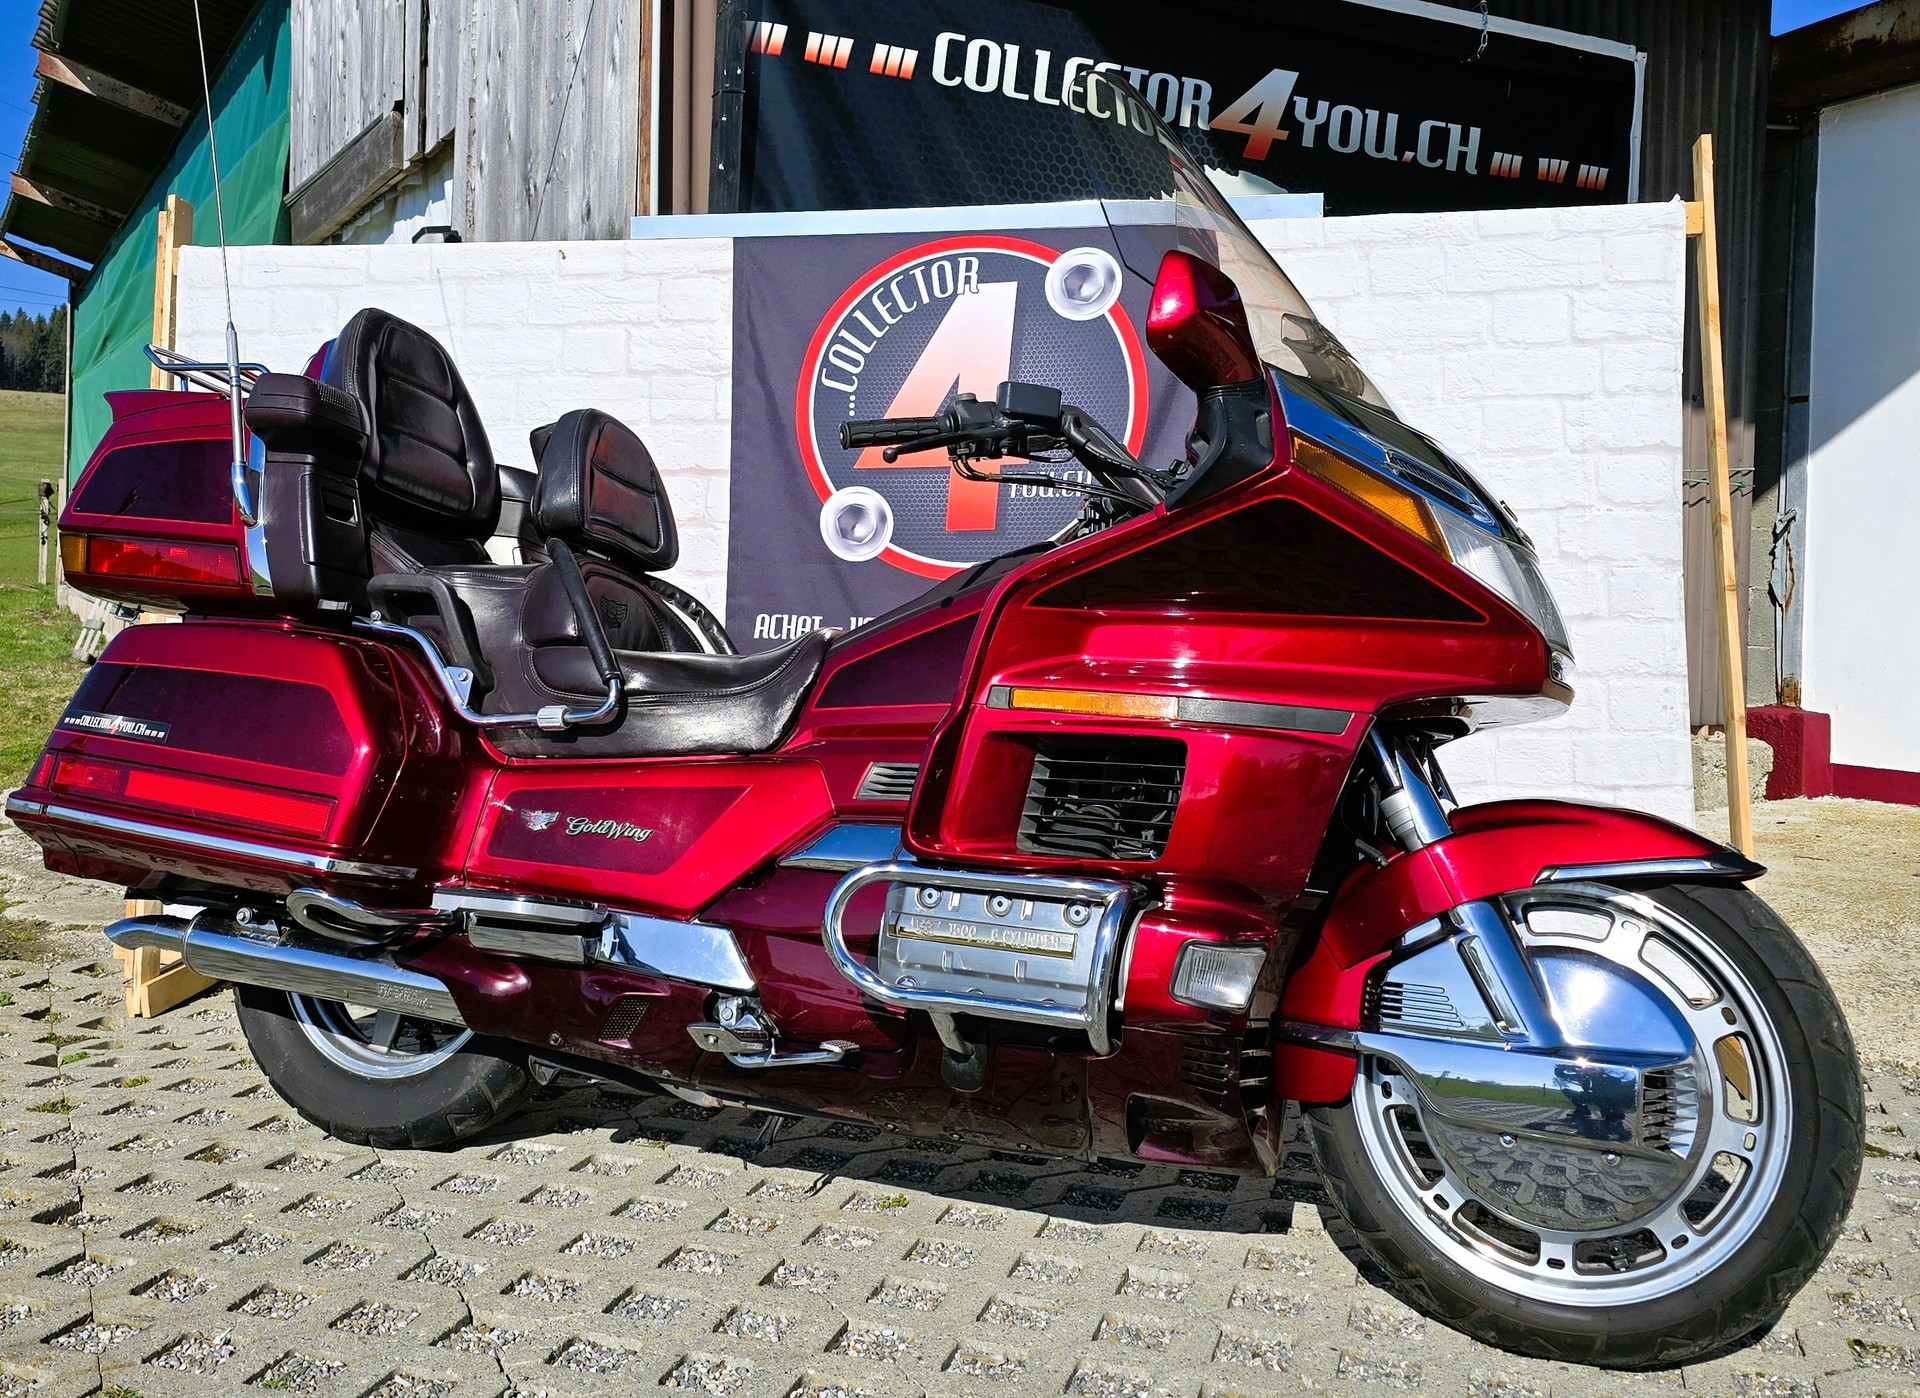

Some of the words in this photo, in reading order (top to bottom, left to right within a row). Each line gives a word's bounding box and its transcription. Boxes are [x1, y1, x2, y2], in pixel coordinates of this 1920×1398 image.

[853, 281, 1030, 532] 4
[754, 613, 823, 640] ACHAT
[948, 922, 977, 937] 1500
[991, 928, 999, 941] 6
[1003, 930, 1061, 949] CYLINDER
